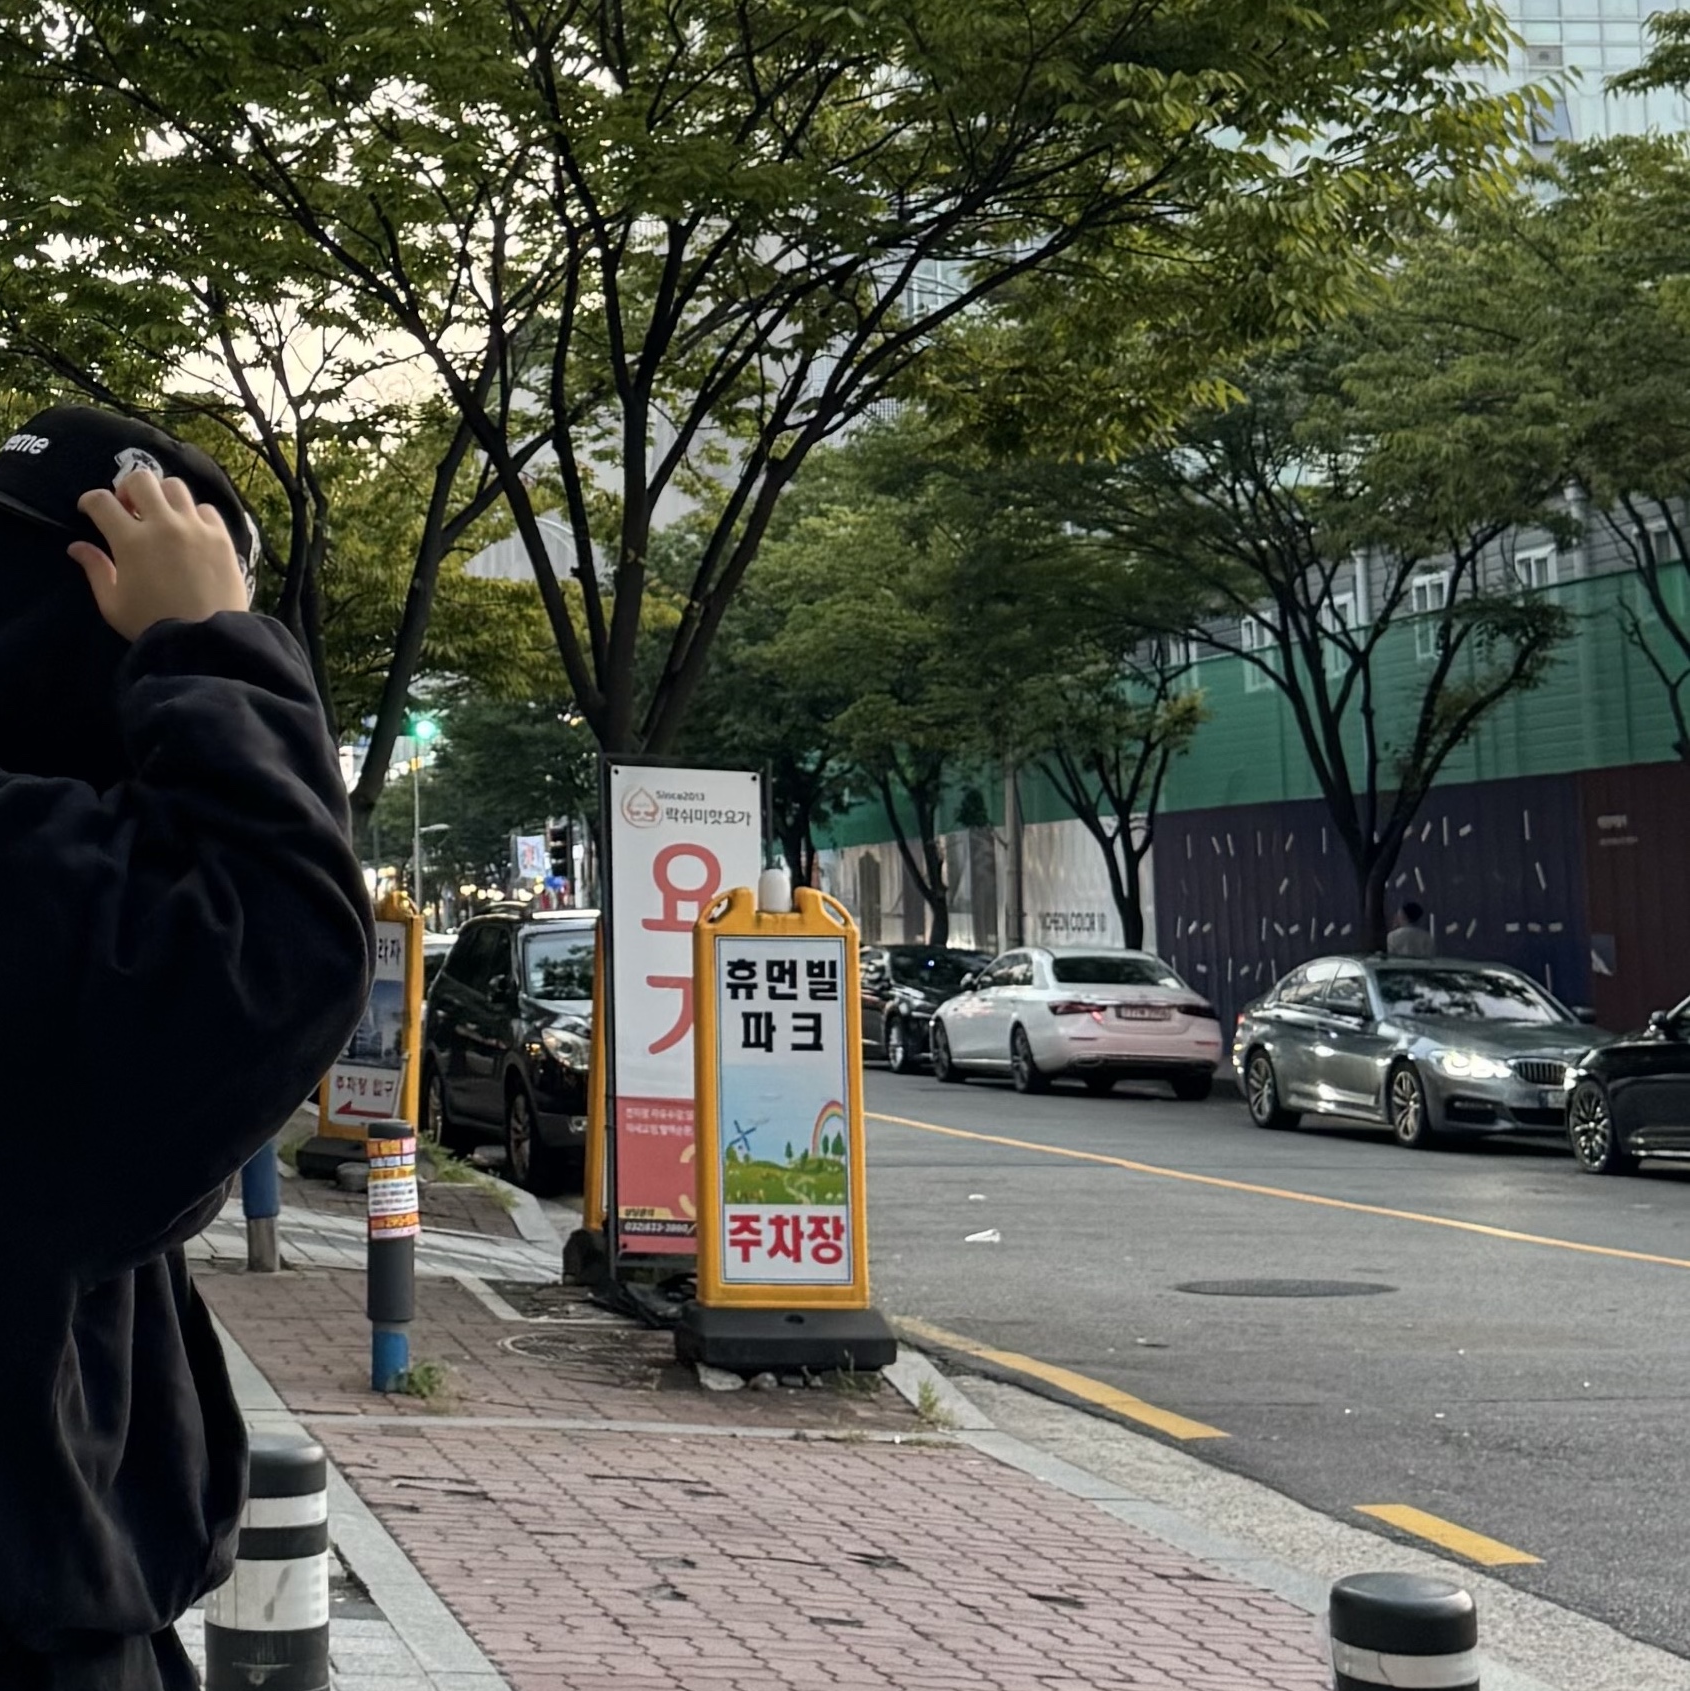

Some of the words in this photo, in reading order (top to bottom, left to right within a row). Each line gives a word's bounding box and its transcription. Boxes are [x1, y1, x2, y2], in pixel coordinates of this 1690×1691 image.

[726, 958, 838, 1001] 휴먼빌
[741, 1010, 824, 1053] 파크
[728, 1213, 846, 1266] 주차장
